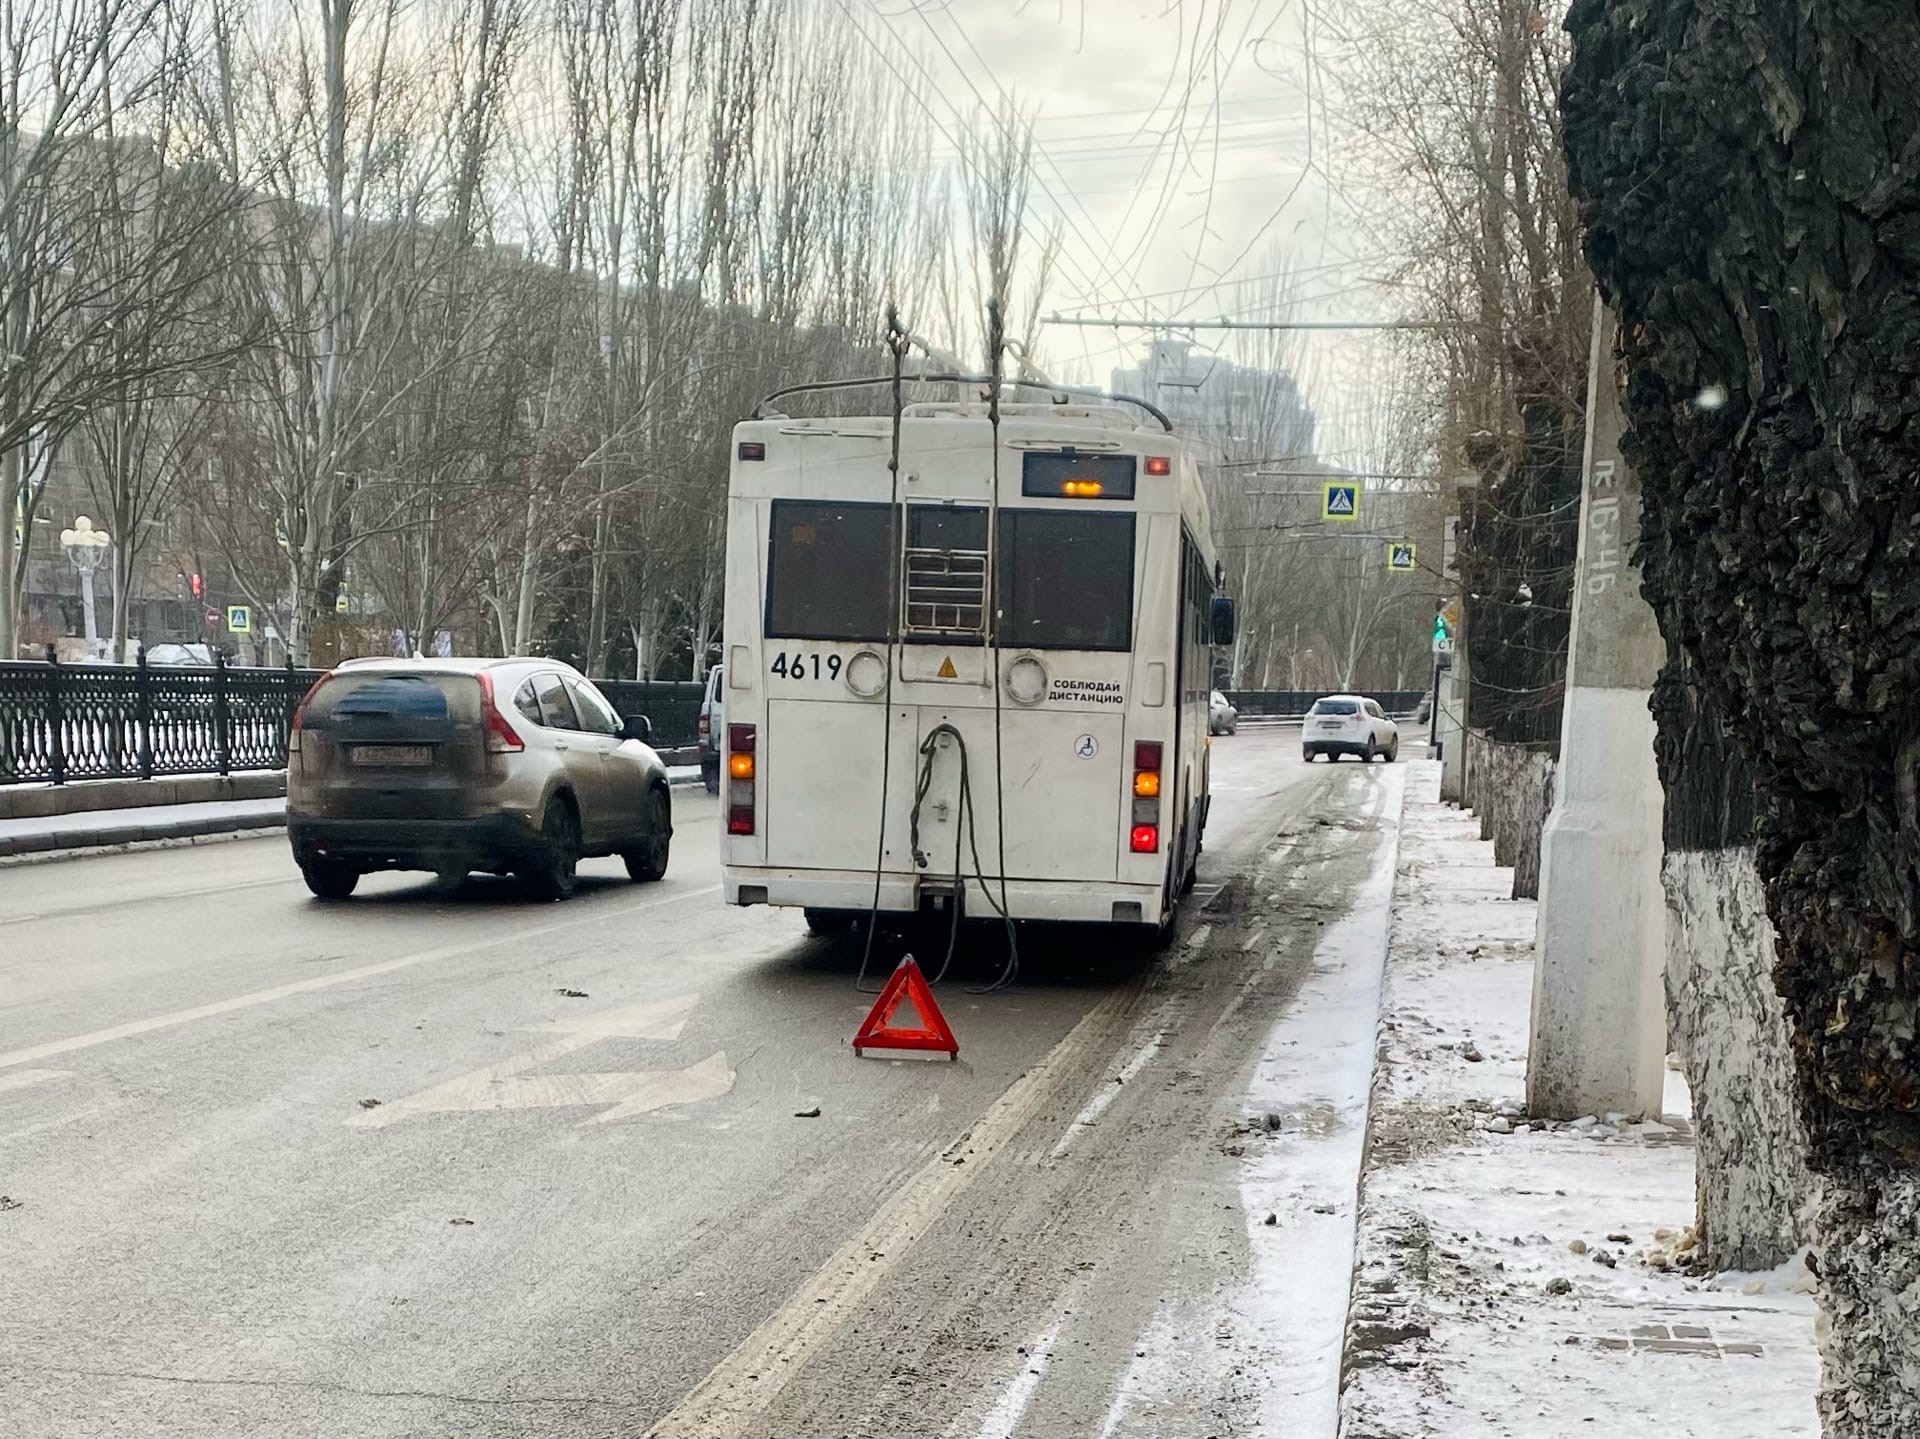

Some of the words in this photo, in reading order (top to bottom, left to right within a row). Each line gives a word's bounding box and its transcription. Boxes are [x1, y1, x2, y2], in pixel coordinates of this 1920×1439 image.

[1438, 639, 1454, 650] СТ
[771, 652, 842, 680] 4619
[1054, 679, 1121, 692] СОБЛЮДАЙ
[1048, 691, 1124, 704] ДИСТАНЦИЮ
